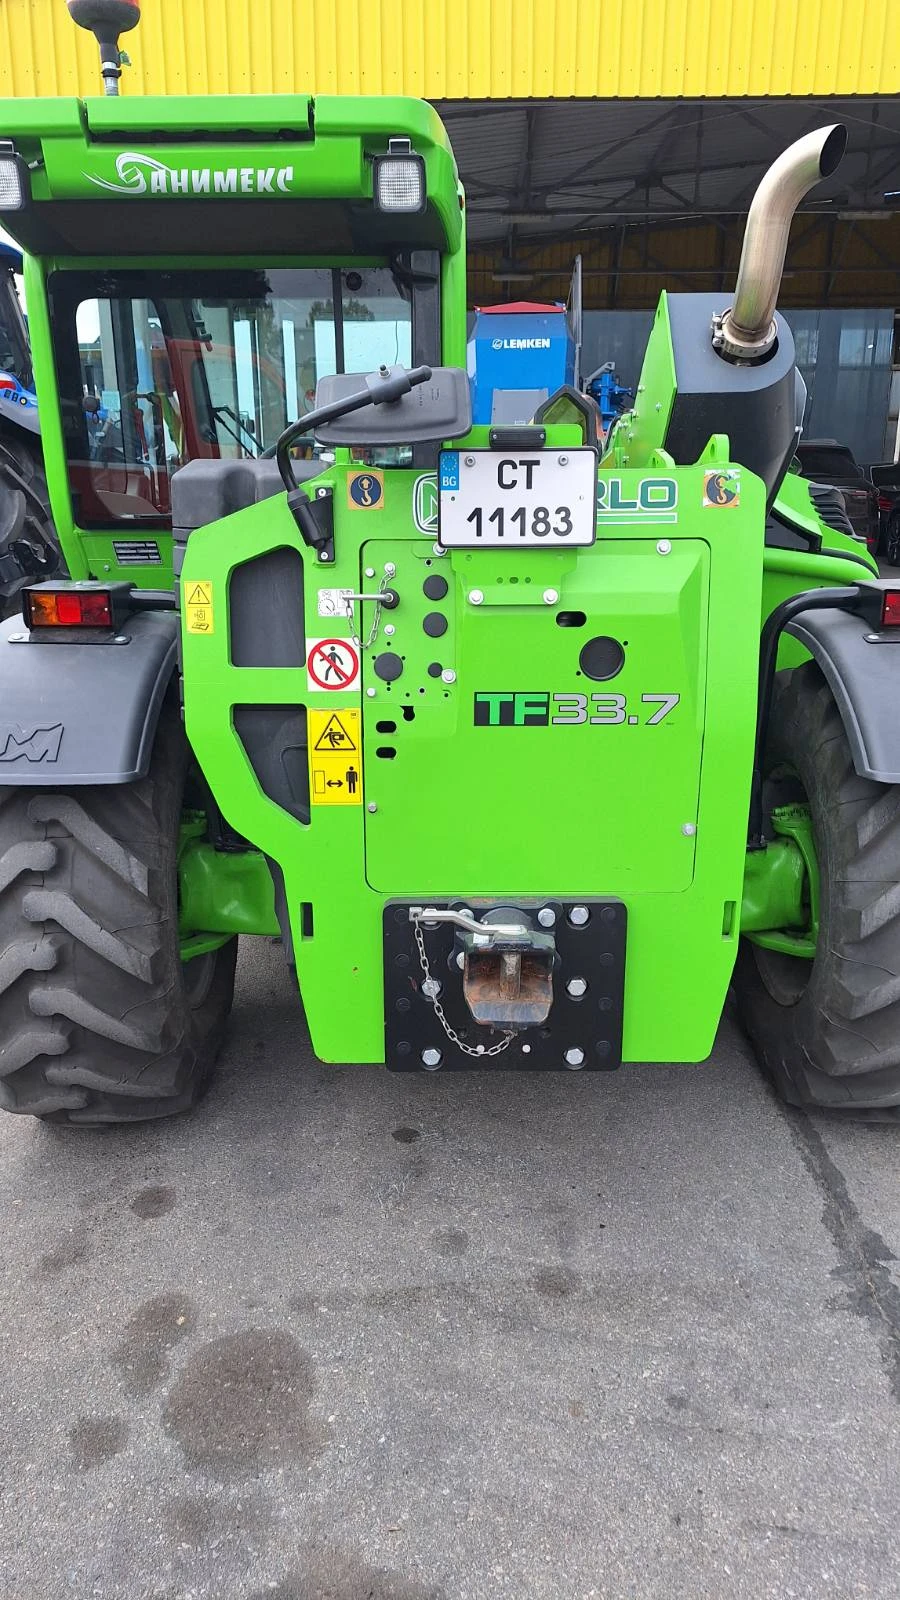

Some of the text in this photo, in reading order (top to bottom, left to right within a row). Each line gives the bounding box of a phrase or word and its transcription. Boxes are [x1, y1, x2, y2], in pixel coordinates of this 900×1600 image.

[151, 166, 294, 193] АНИМЕКС
[503, 338, 551, 349] LEMKEN
[442, 475, 457, 487] BG
[497, 459, 541, 490] CT
[466, 506, 574, 537] 11183
